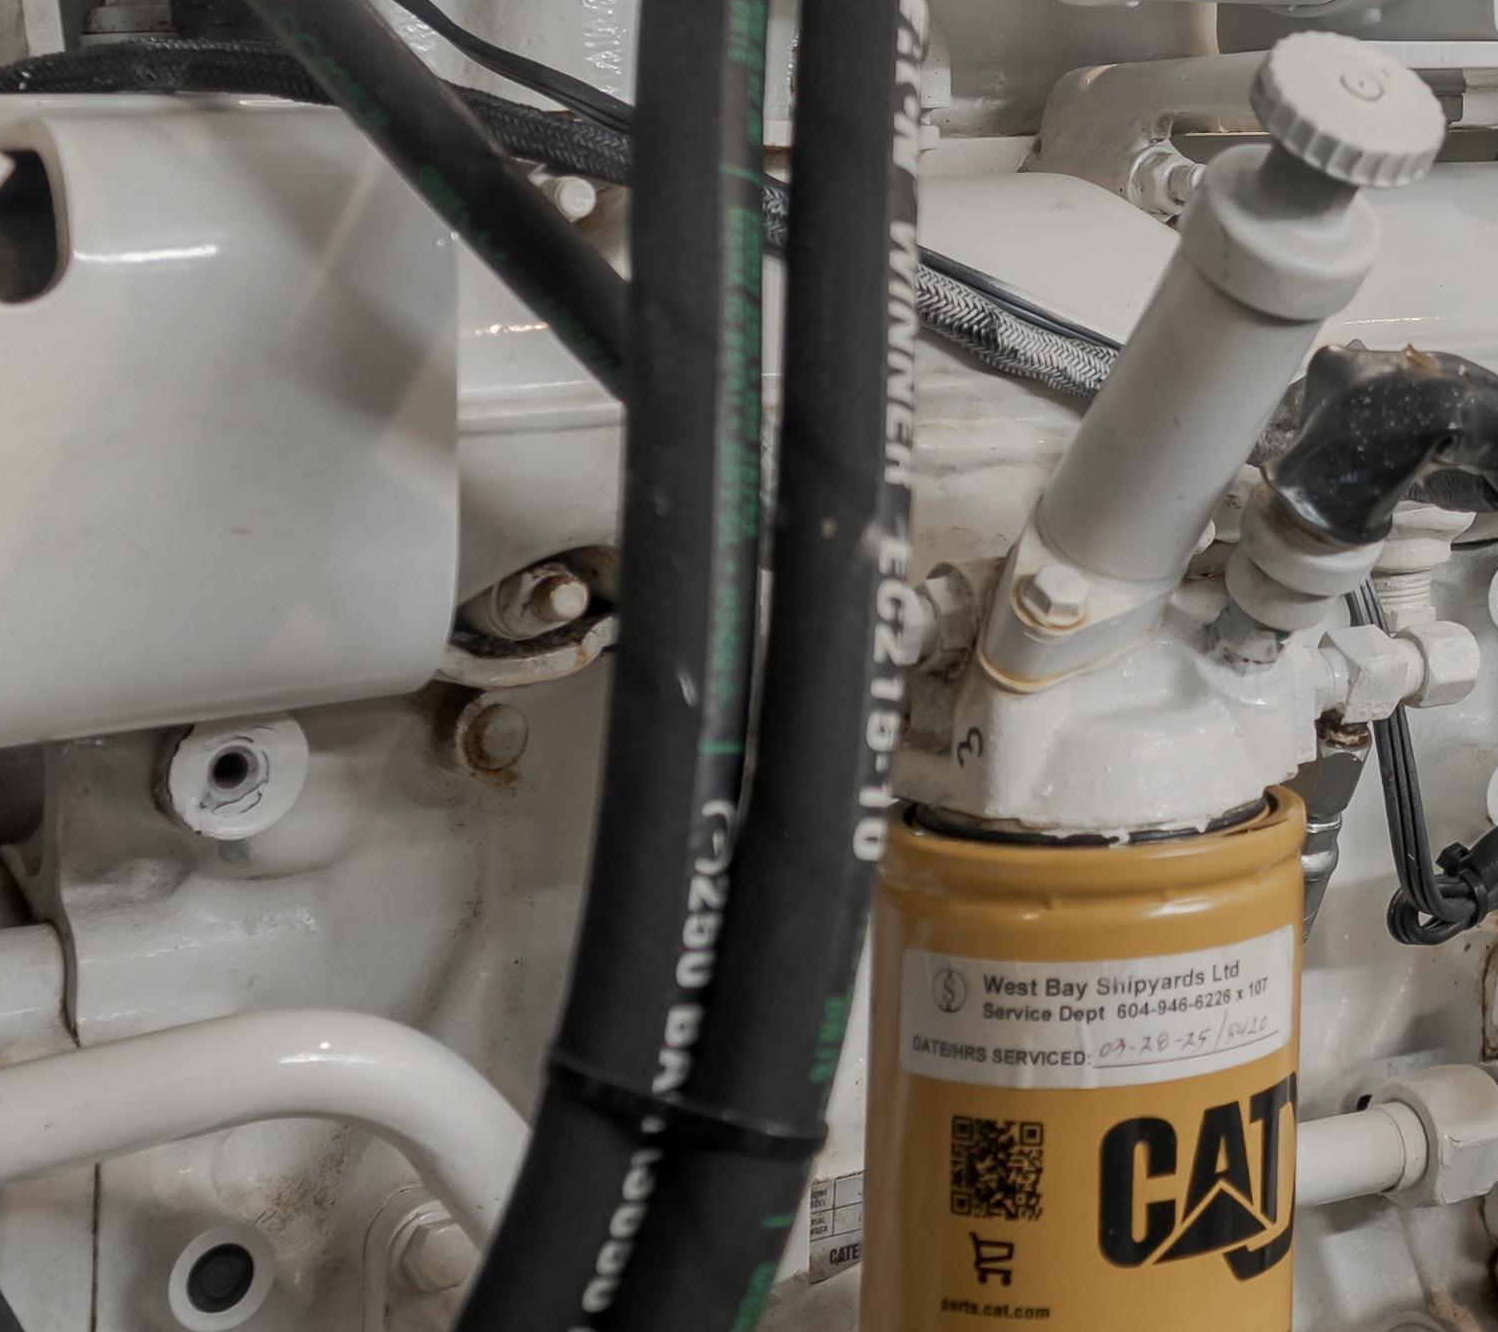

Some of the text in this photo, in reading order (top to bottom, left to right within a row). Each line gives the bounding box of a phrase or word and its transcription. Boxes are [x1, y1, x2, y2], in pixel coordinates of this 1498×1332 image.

[982, 978, 1268, 1024] Service Dept 604-946-6226 x 107
[983, 961, 1240, 1001] West Bay Shipyards Ltd
[913, 1035, 1092, 1066] DATE/HRS SERVICED:
[1098, 1072, 1297, 1269] CAT
[940, 1298, 1050, 1320] parts.cat.com
